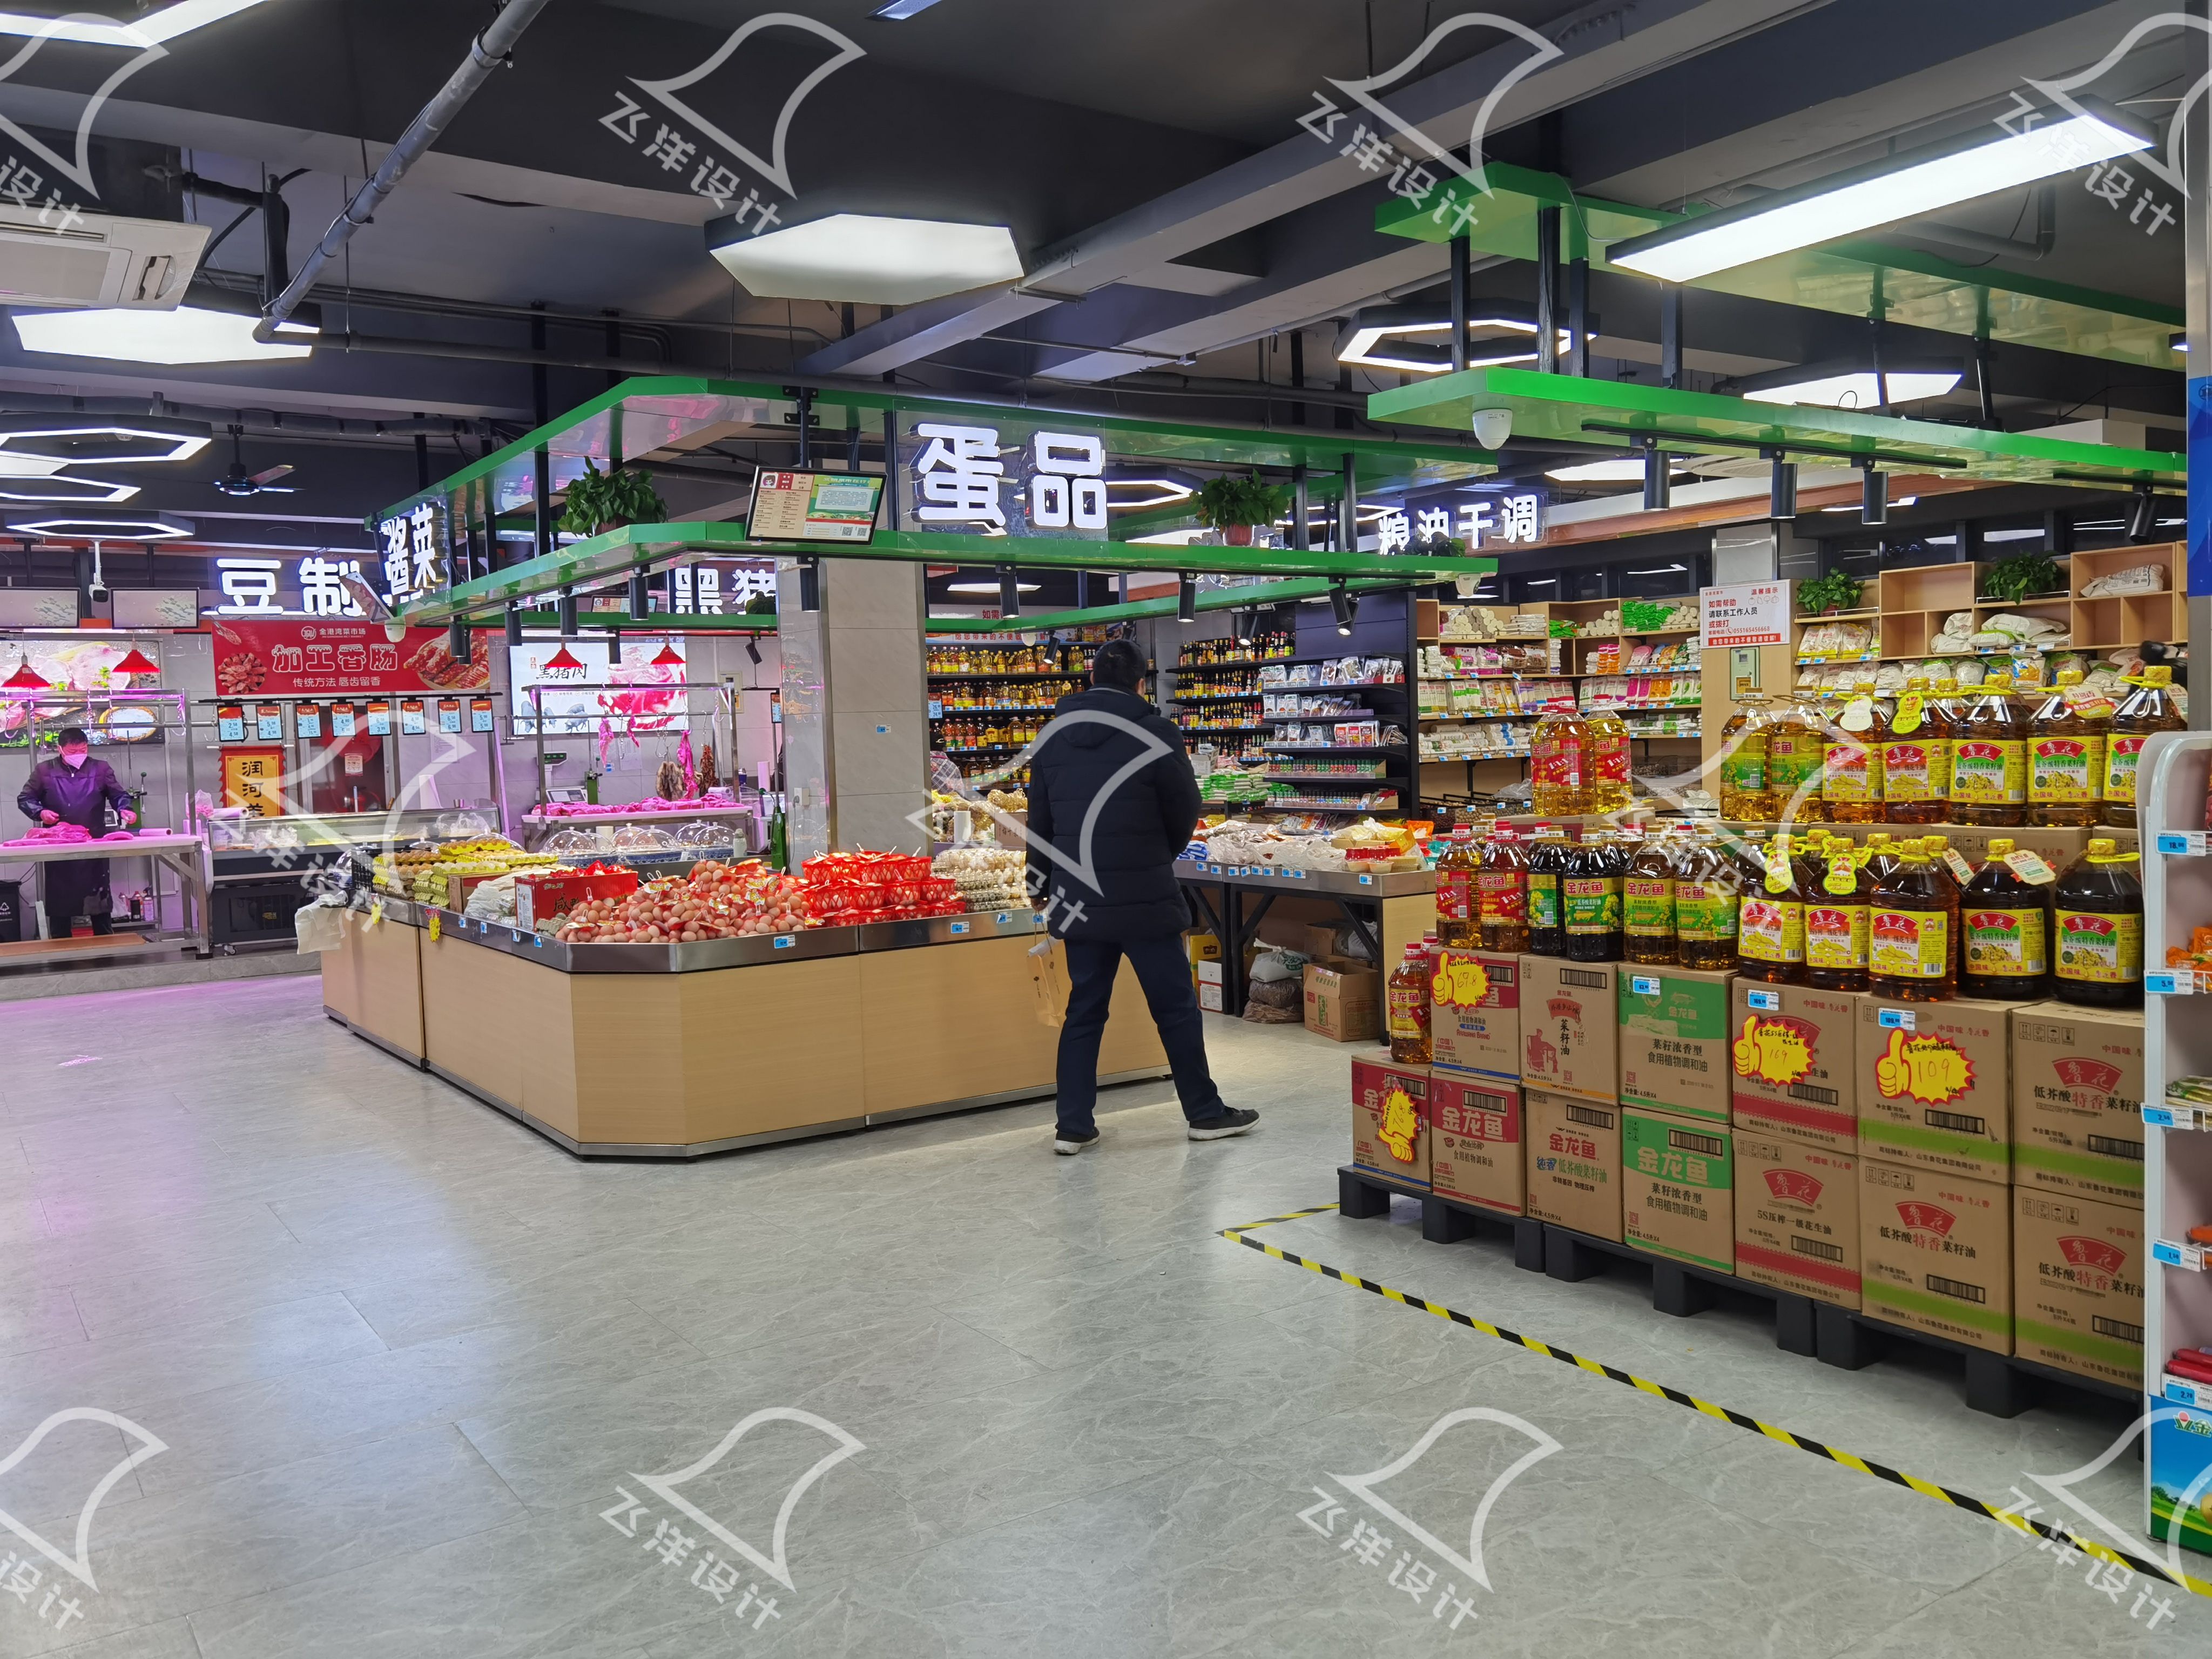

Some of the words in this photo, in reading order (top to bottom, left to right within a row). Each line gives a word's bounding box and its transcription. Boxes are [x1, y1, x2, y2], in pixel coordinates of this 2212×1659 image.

[918, 423, 1107, 529] 蛋品
[1378, 494, 1538, 555] 粮油干调
[384, 502, 436, 599] 酱菜
[1751, 586, 1778, 596] 温馨提示
[1708, 598, 1737, 609] 如需帮助
[1708, 606, 1758, 619] 请联系工作人员
[1708, 619, 1729, 629] 或拨打
[319, 628, 366, 636] 金港湾菜市场
[271, 644, 398, 673] 加工香肠
[536, 663, 588, 680] 黑猪肉
[293, 677, 337, 688] 传统方法
[339, 677, 381, 687] 唇齿留香
[1967, 745, 1992, 757] 鲁花
[2049, 741, 2074, 755] 鲁花
[2107, 790, 2128, 798] 中国味
[1566, 881, 1604, 894] 金龙鱼
[1627, 881, 1666, 896] 金龙鱼
[1676, 885, 1706, 899] 金龙鱼
[1750, 903, 1772, 917] 鲁花
[1815, 911, 1839, 925] 鲁花
[1881, 916, 1906, 929] 鲁花
[1980, 914, 2005, 928] 鲁花
[2074, 917, 2101, 931] 鲁花
[1390, 991, 1420, 1003] 金龙鱼
[1557, 989, 1573, 997] 金龙鱼
[1803, 1000, 1825, 1010] 中国味
[1937, 1024, 1964, 1034] 中国味
[1560, 1019, 1570, 1056] 菜籽油
[1652, 1038, 1703, 1057] 菜籽浓香型
[2102, 1044, 2132, 1056] 中国味
[1647, 1051, 1708, 1073] 食用植物调和油
[1769, 1048, 1788, 1066] 169
[1918, 1058, 1950, 1084] 109
[2066, 1061, 2110, 1088] 鲁花
[1442, 1105, 1504, 1142] 金龙鱼
[1549, 1132, 1597, 1161] 金龙鱼
[1453, 1150, 1494, 1168] 食用植物调和油
[1637, 1146, 1709, 1185] 金龙鱼
[1805, 1155, 1829, 1166] 中国味
[1558, 1158, 1608, 1184] 低芥酸菜籽油
[1552, 1175, 1573, 1187] 非转基因
[1574, 1182, 1595, 1192] 物理压榨
[1775, 1172, 1812, 1201] 鲁花
[1651, 1182, 1703, 1205] 菜籽浓香型
[1938, 1190, 1964, 1203] 中国味
[1645, 1195, 1708, 1222] 食用植物调和油
[1757, 1209, 1832, 1236] 5S压榨一级花生油
[1906, 1205, 1945, 1232] 鲁花
[2106, 1226, 2136, 1239] 中国味
[1880, 1226, 1977, 1259] 低芥酸特香菜籽油
[2071, 1240, 2113, 1269] 鲁花
